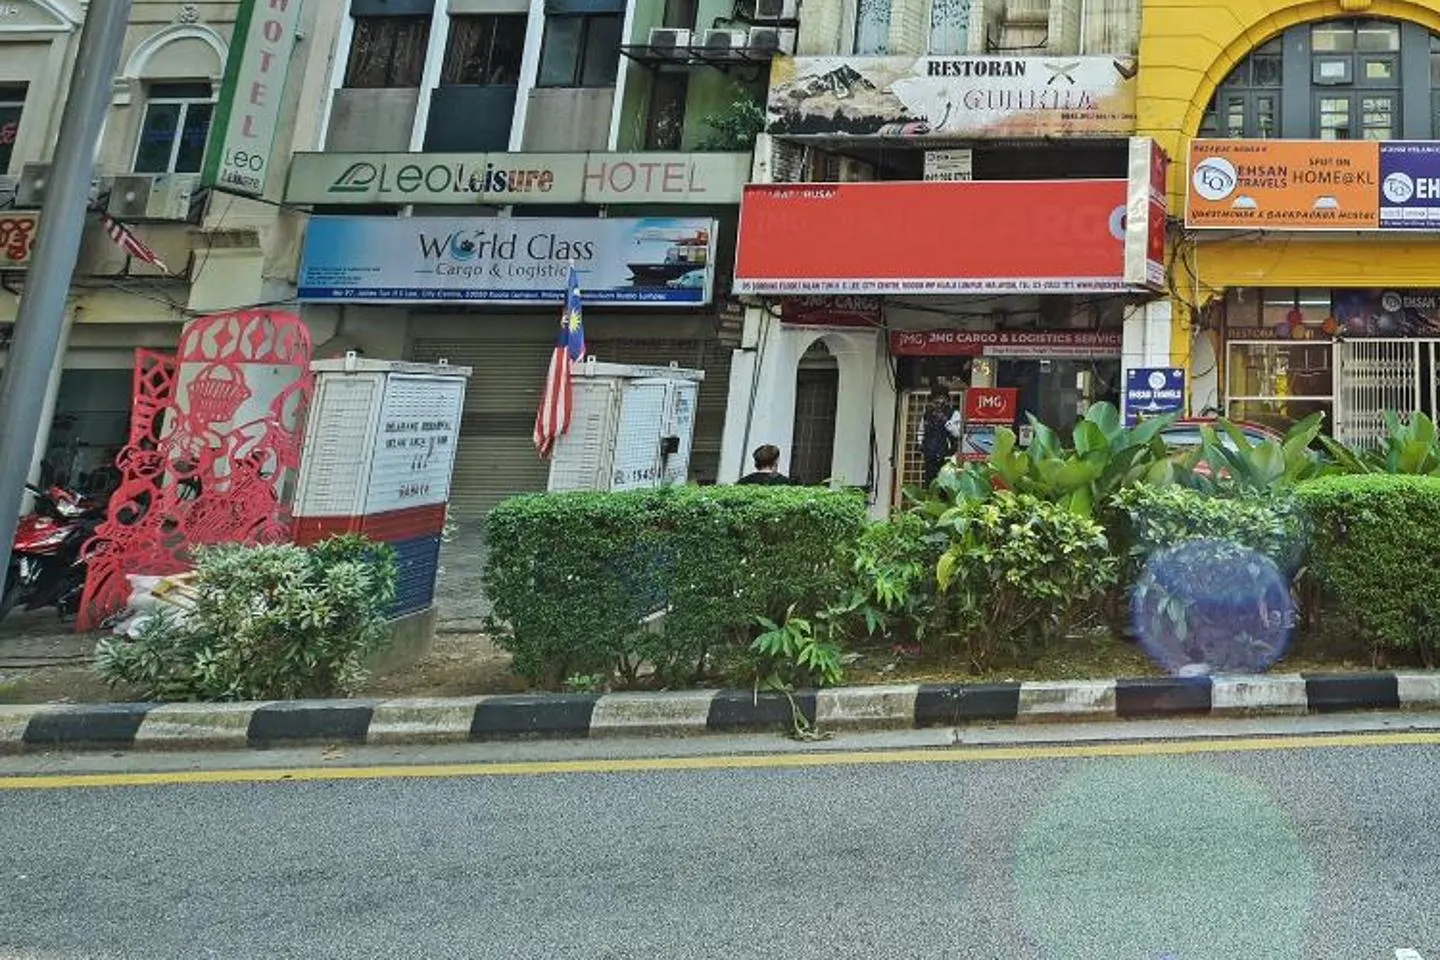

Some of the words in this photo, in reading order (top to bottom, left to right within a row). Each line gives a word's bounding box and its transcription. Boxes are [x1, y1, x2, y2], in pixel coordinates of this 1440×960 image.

[927, 60, 1027, 78] RESTORAN
[582, 161, 708, 194] HOTEL
[1237, 165, 1288, 177] EHSAN
[1292, 170, 1376, 186] HOME@KL
[1238, 177, 1288, 189] TRAVELS
[419, 230, 516, 261] World
[527, 233, 595, 261] Class
[435, 262, 482, 278] Cargo
[488, 264, 501, 276] &
[508, 262, 569, 279] Logistic
[955, 332, 998, 343] CARGO
[999, 333, 1009, 343] &
[1011, 332, 1074, 344] LOGISTICS
[978, 395, 1003, 409] JMG
